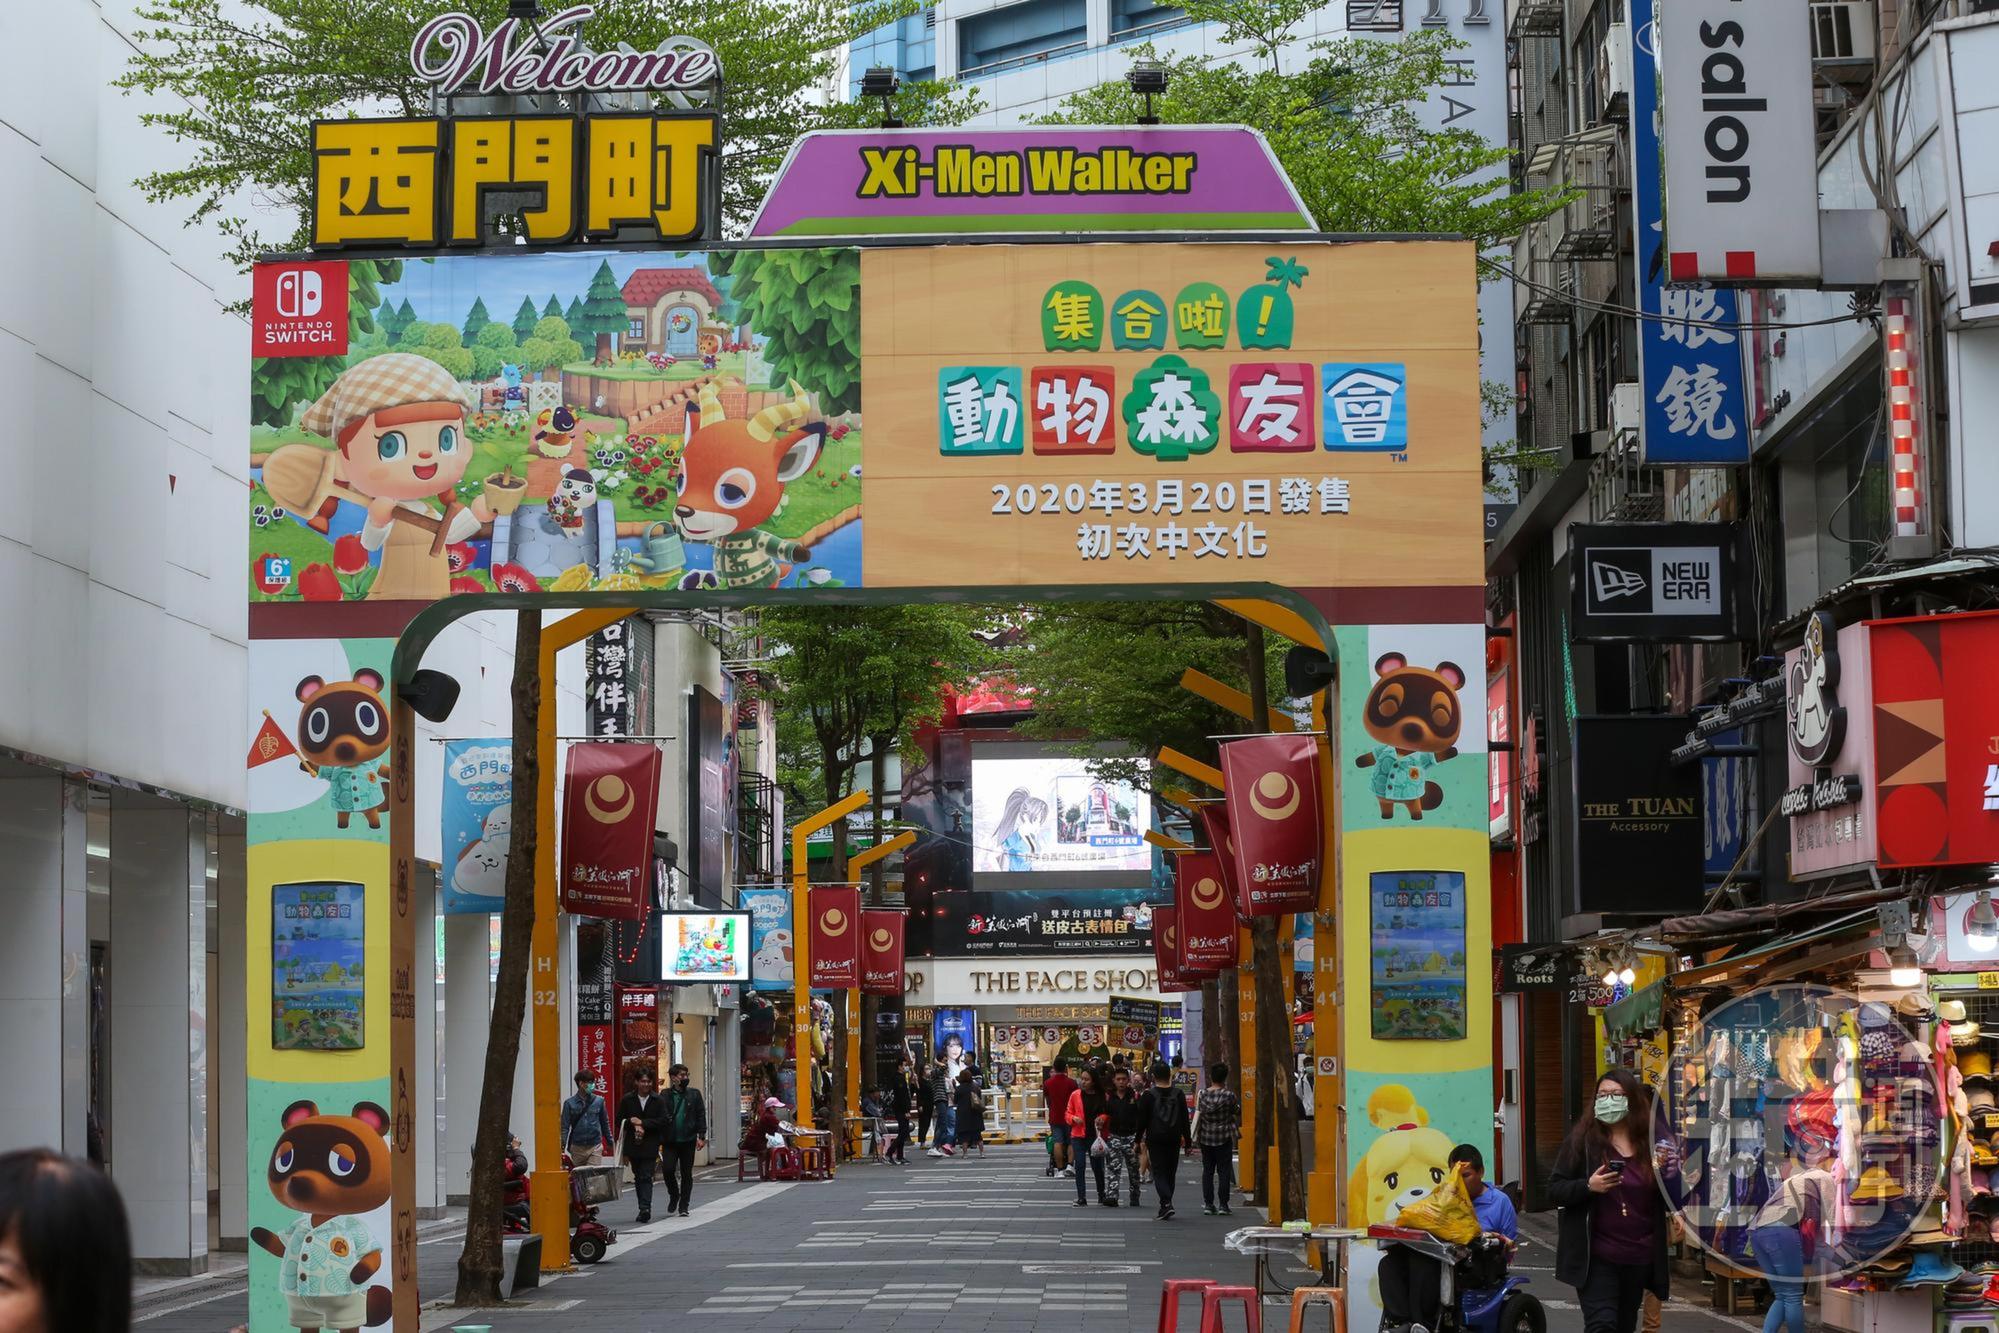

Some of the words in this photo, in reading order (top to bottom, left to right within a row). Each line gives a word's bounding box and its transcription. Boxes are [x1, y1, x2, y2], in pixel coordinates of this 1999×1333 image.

[410, 5, 717, 94] Welcome
[1699, 19, 1768, 203] salon
[857, 146, 1024, 198] Xi-Men
[1028, 146, 1197, 196] Walker
[312, 116, 717, 246] 西門町
[265, 321, 333, 330] NINTENDO
[265, 330, 332, 344] SWITCH
[1655, 284, 1737, 441] 眼鏡
[944, 364, 1402, 445] 動物森友會
[991, 478, 1351, 516] 2020年3月20日發售
[1077, 520, 1269, 559] 初次中文化
[1662, 562, 1710, 580] NEW
[1663, 582, 1711, 600] ERA
[1584, 803, 1620, 817] THE
[1627, 798, 1695, 816] TUAN
[1610, 821, 1670, 833] Accessory
[1041, 919, 1129, 935] 送皮古表情包
[538, 957, 551, 973] H
[1320, 957, 1334, 973] H
[970, 971, 1021, 992] THE
[1026, 970, 1088, 993] FACE
[1093, 969, 1158, 992] SHOP
[1516, 974, 1554, 984] Roots
[534, 991, 556, 1006] 32
[622, 993, 655, 1007] 伴手禮
[1316, 991, 1338, 1006] 41
[798, 1005, 806, 1014] H
[1016, 1007, 1042, 1019] THE
[796, 1024, 809, 1033] 30
[582, 1035, 590, 1068] Handmad
